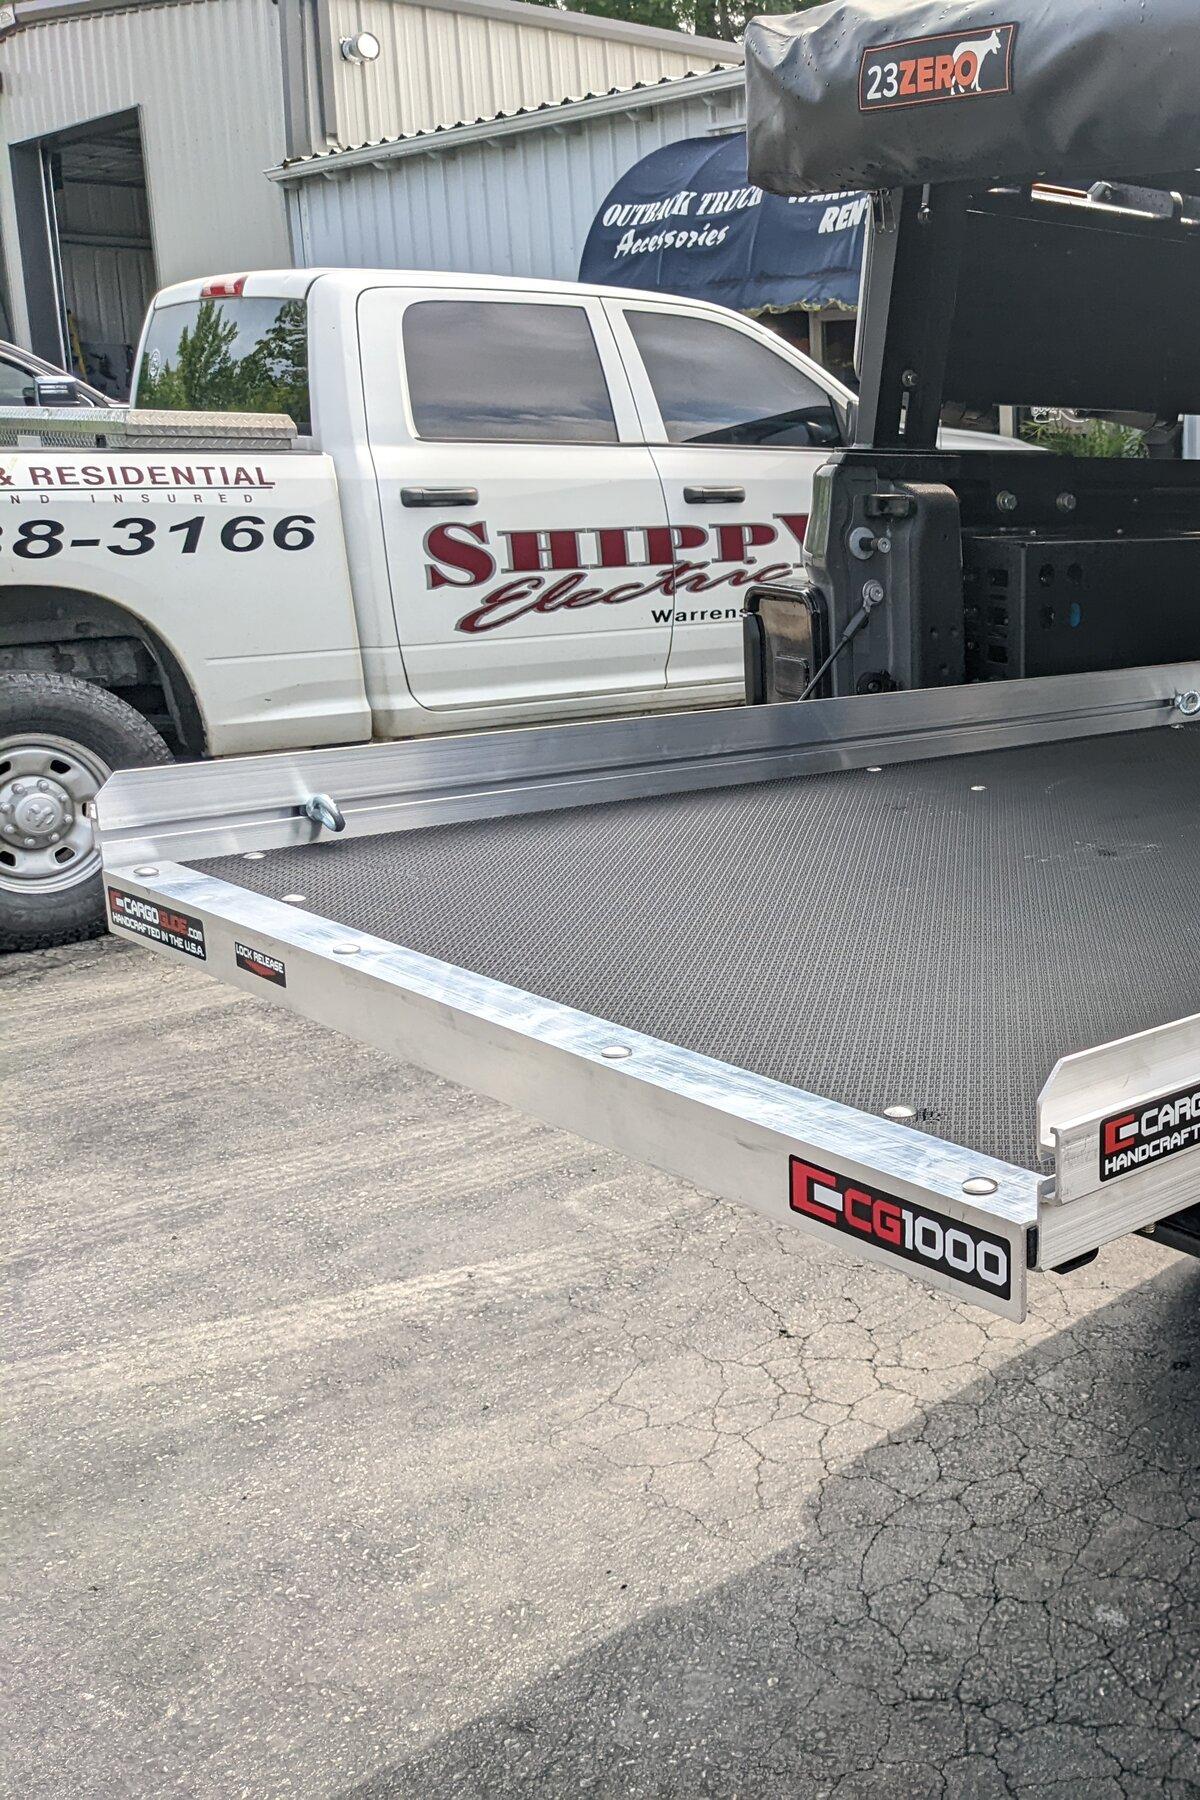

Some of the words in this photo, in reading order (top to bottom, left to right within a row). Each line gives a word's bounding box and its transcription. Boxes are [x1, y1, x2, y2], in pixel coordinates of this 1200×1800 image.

[866, 50, 978, 100] 23ZERO
[602, 190, 698, 227] OUTBACK
[613, 222, 730, 259] Accessories
[28, 465, 276, 486] RESIDENTIAL
[91, 492, 253, 505] INSURED
[0, 515, 317, 560] 8-3166
[454, 560, 793, 634] Electric
[111, 911, 161, 940] HANDCRAFTED
[161, 929, 169, 943] IN
[168, 934, 184, 949] THE
[235, 943, 253, 960] LOCK
[253, 950, 284, 974] RELEASE
[844, 1187, 1008, 1287] CG1000
